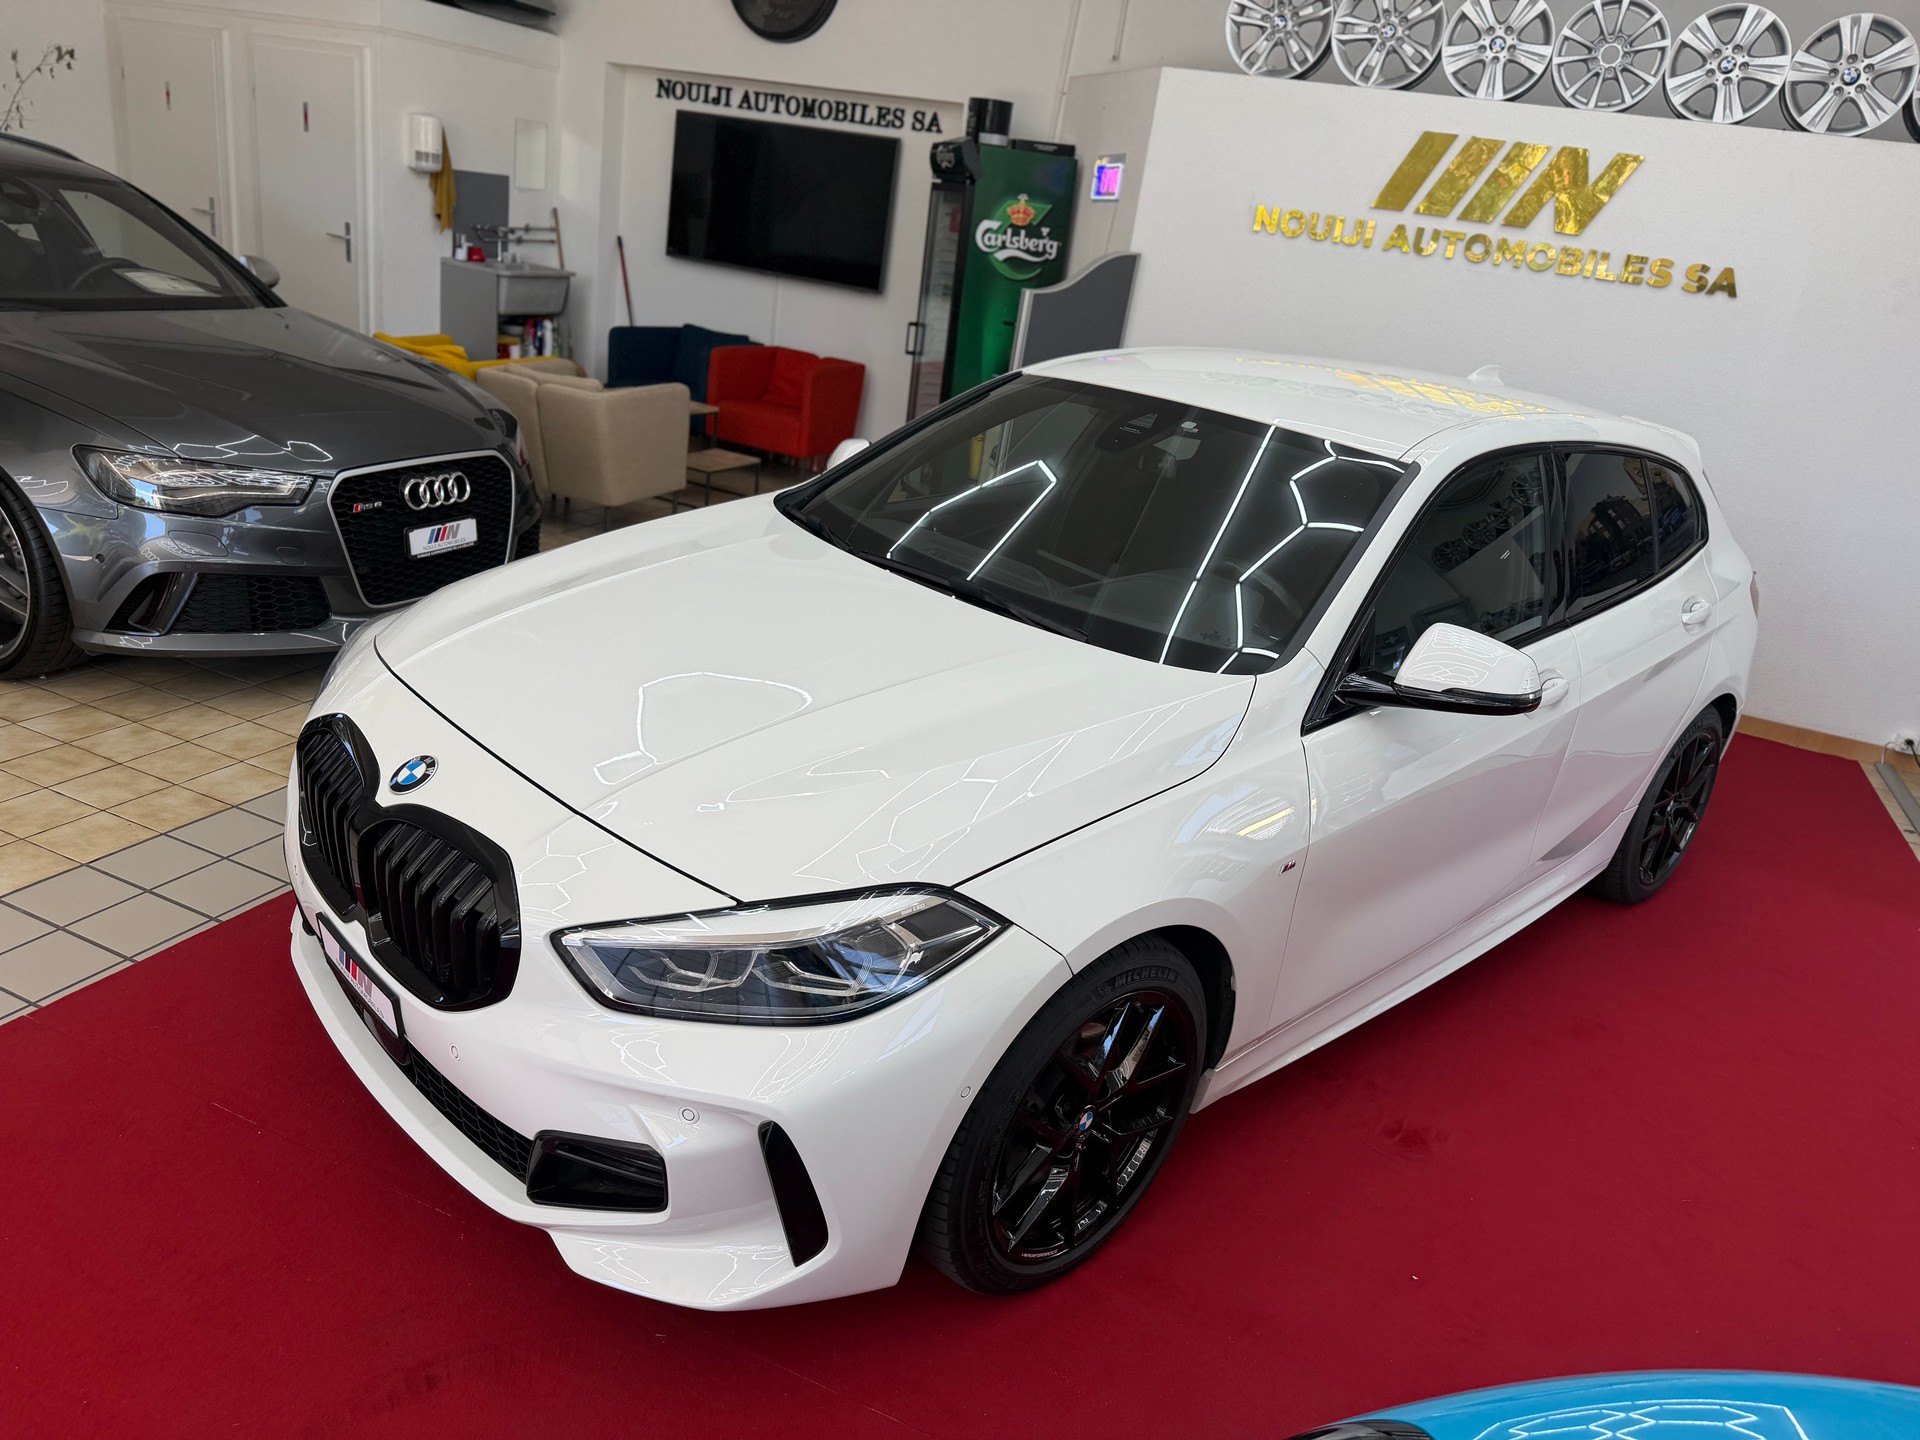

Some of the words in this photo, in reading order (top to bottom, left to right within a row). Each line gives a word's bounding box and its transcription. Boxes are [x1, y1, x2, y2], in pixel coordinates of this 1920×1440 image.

[656, 78, 733, 107] NOUIJI
[738, 90, 905, 129] AUTOMOBILES
[911, 110, 943, 133] SA
[975, 219, 1059, 260] Carlsberg
[1252, 204, 1377, 248] NOUIJI
[1382, 224, 1675, 288] AUTOMOBILES
[1682, 263, 1738, 299] SA
[1114, 966, 1177, 988] MICHELIN
